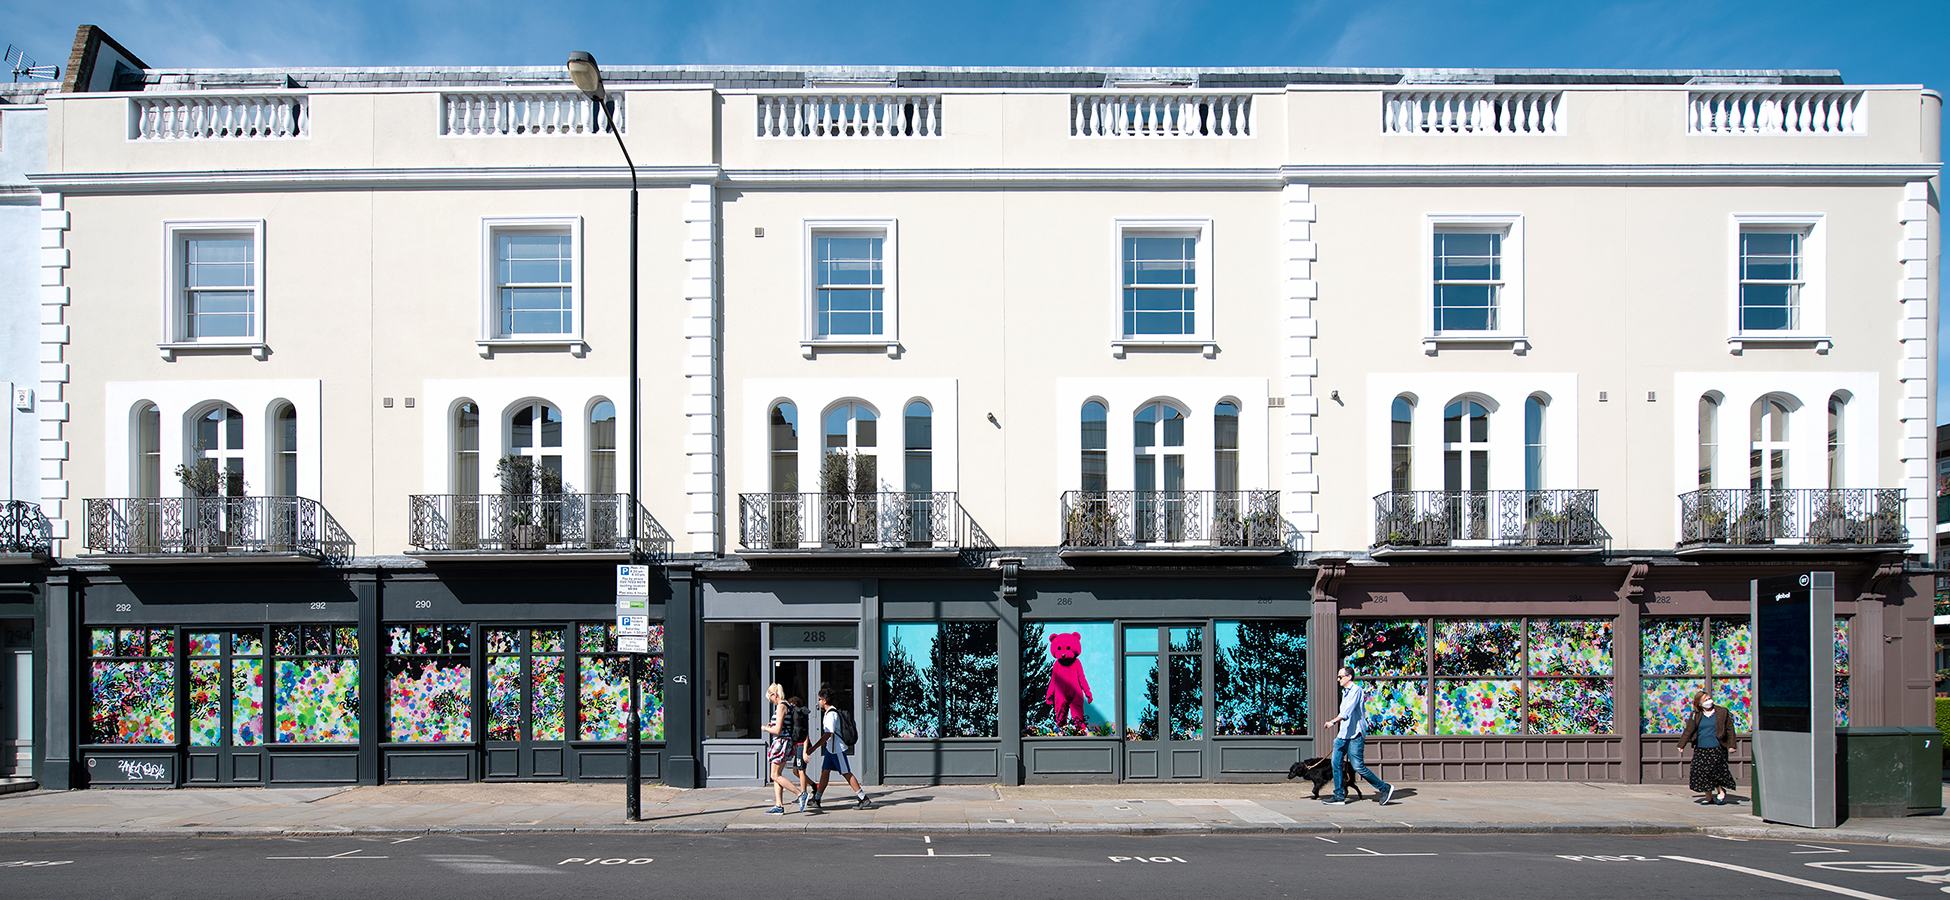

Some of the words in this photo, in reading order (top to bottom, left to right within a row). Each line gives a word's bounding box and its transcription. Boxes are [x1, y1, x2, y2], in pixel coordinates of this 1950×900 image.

[1775, 592, 1791, 601] global
[115, 604, 132, 612] 292
[415, 600, 432, 608] 290
[7, 630, 31, 643] 294
[803, 631, 826, 642] 288
[1925, 740, 1930, 748] 7
